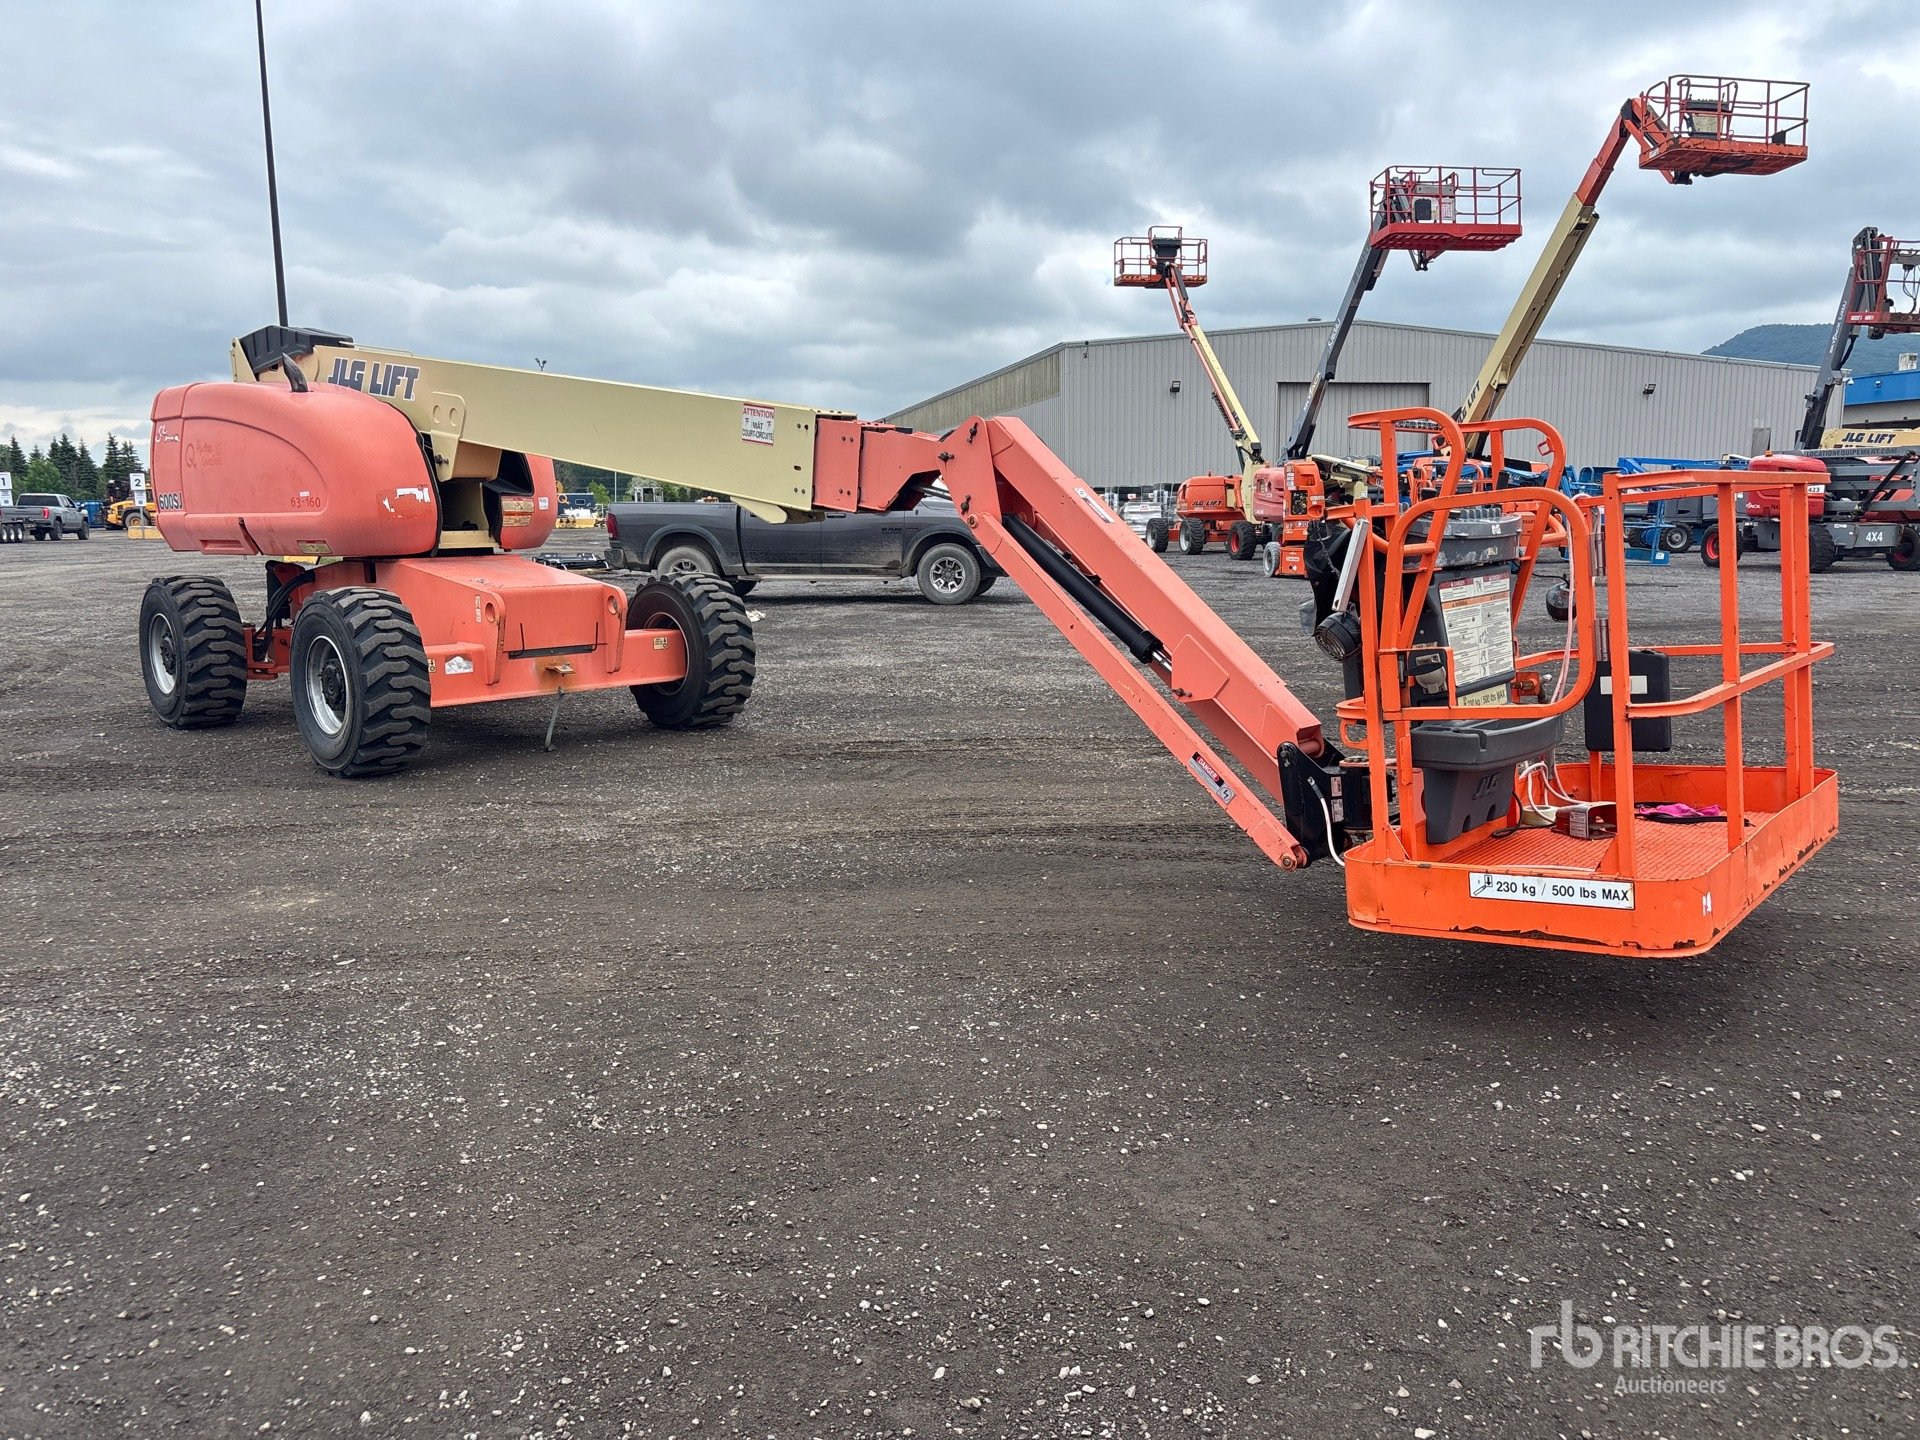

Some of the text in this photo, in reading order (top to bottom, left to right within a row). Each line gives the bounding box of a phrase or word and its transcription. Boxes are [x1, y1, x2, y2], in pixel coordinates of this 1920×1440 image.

[327, 357, 420, 400] JLG LIFT
[1467, 379, 1481, 409] LIFT
[743, 408, 774, 419] ATTENTION
[1842, 432, 1897, 444] JLG LIFT
[134, 478, 142, 487] 2
[158, 491, 183, 510] 600SJ
[290, 496, 321, 509] 63-160
[1865, 531, 1884, 543] 4X4
[1197, 758, 1219, 780] DANGER
[1496, 881, 1629, 901] 230 kg / 500 lbs MAX
